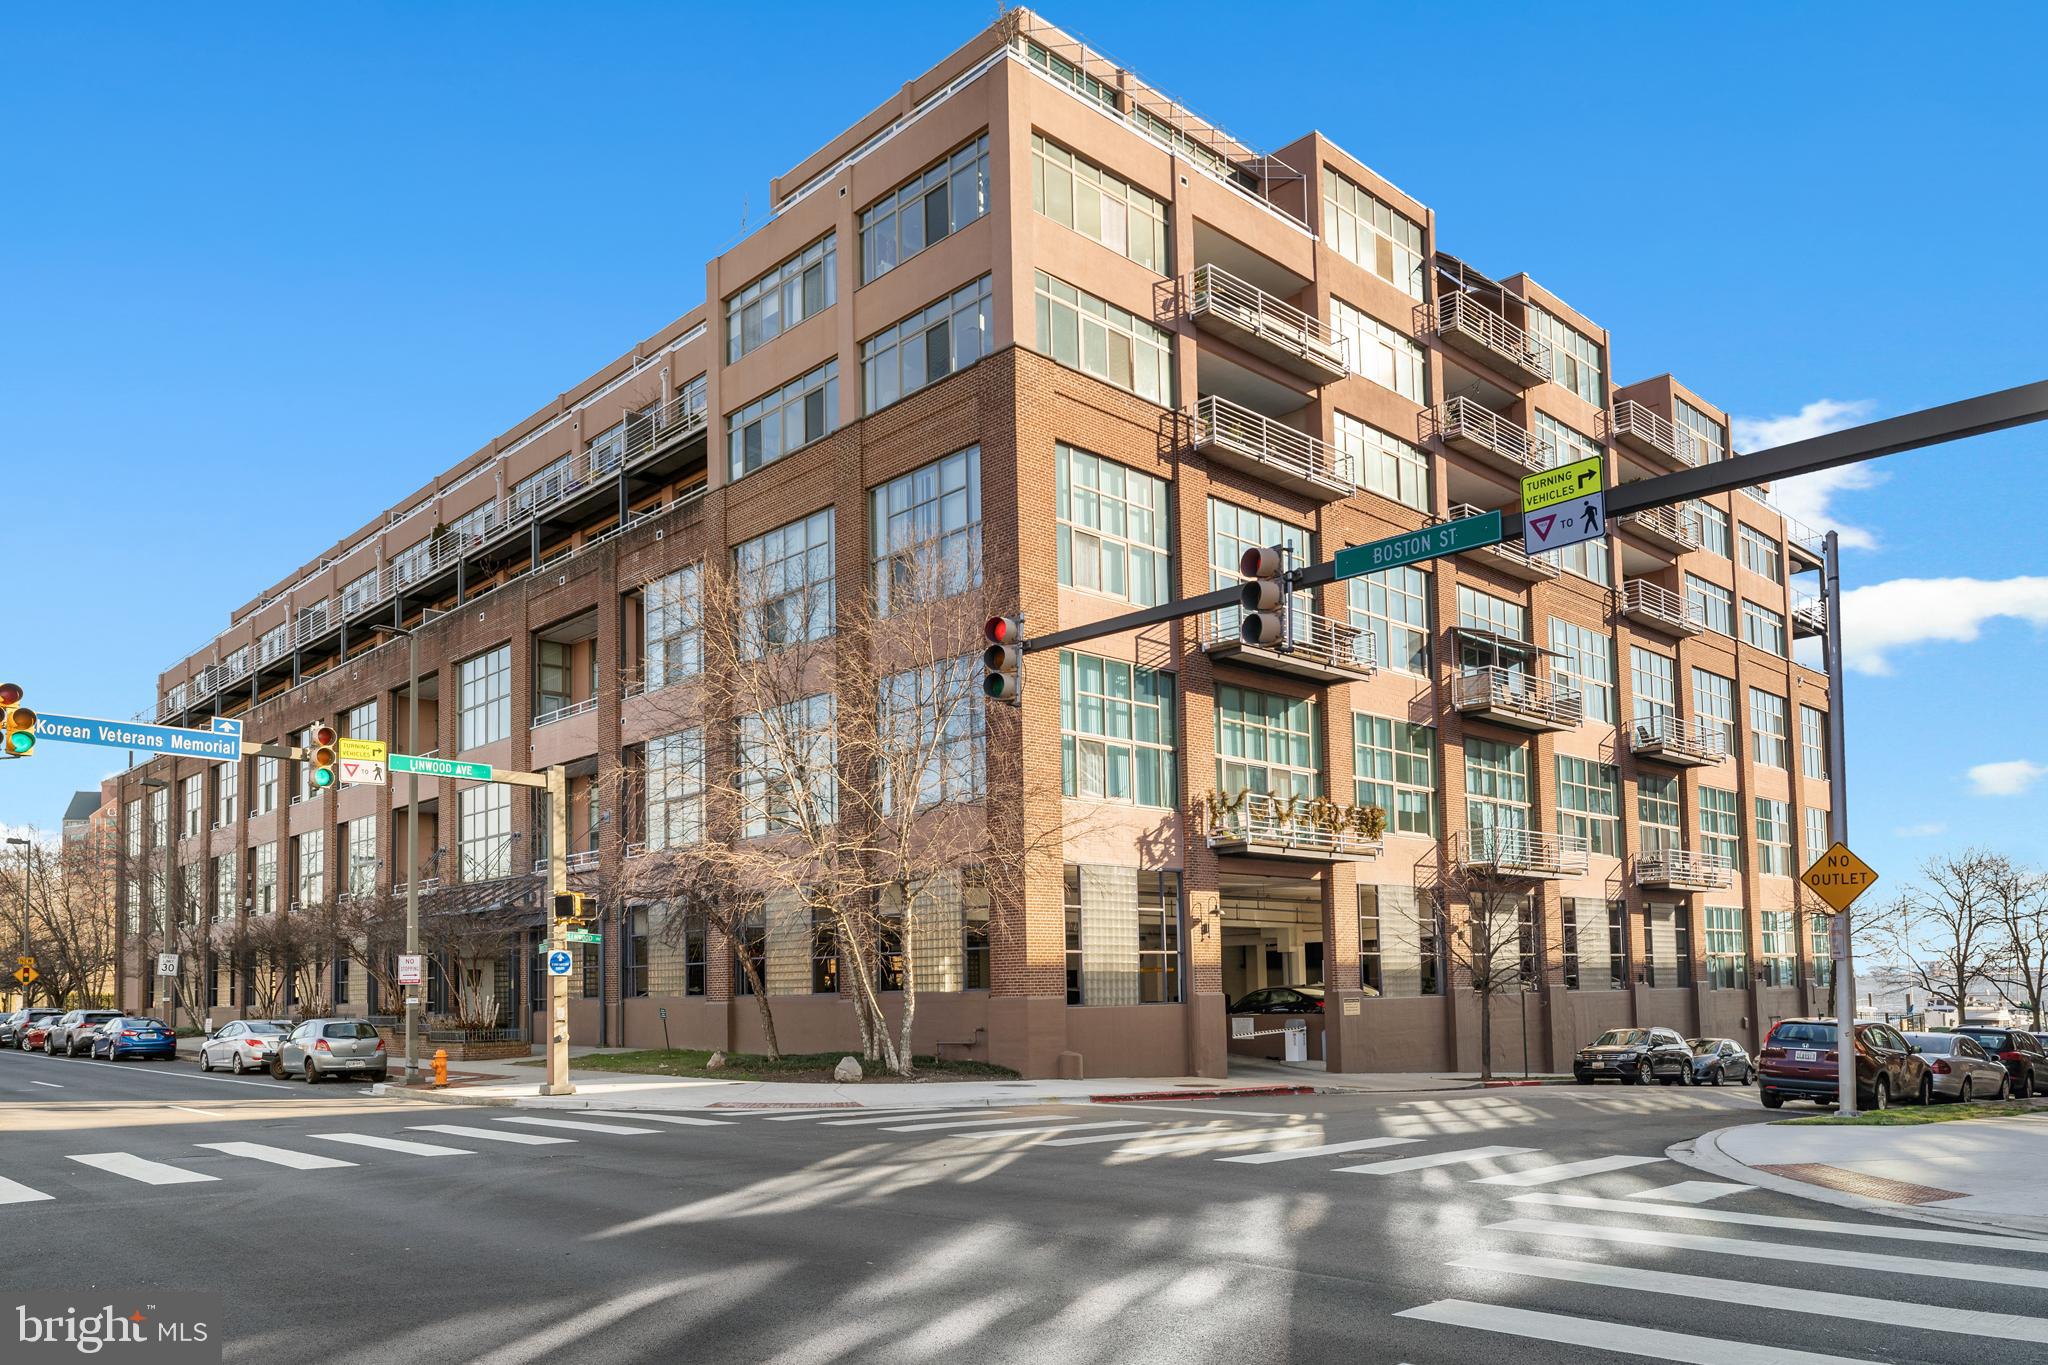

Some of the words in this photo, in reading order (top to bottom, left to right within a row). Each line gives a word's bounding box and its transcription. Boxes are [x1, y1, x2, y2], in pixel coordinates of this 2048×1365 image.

[1527, 471, 1572, 491] TURNING
[1526, 485, 1575, 506] VEHICLES
[1560, 518, 1573, 529] TO
[1372, 534, 1431, 564] BOSTON
[1439, 527, 1457, 548] ST
[36, 718, 91, 740] Korean
[98, 726, 164, 748] Veterans
[171, 734, 235, 755] Memorial
[343, 742, 370, 750] TURNING
[342, 750, 371, 758] VEHICLES
[409, 759, 452, 773] LINWOOD
[455, 764, 473, 776] AVE
[1828, 855, 1849, 868] NO
[1811, 872, 1868, 886] OUTLET
[161, 963, 175, 972] 30
